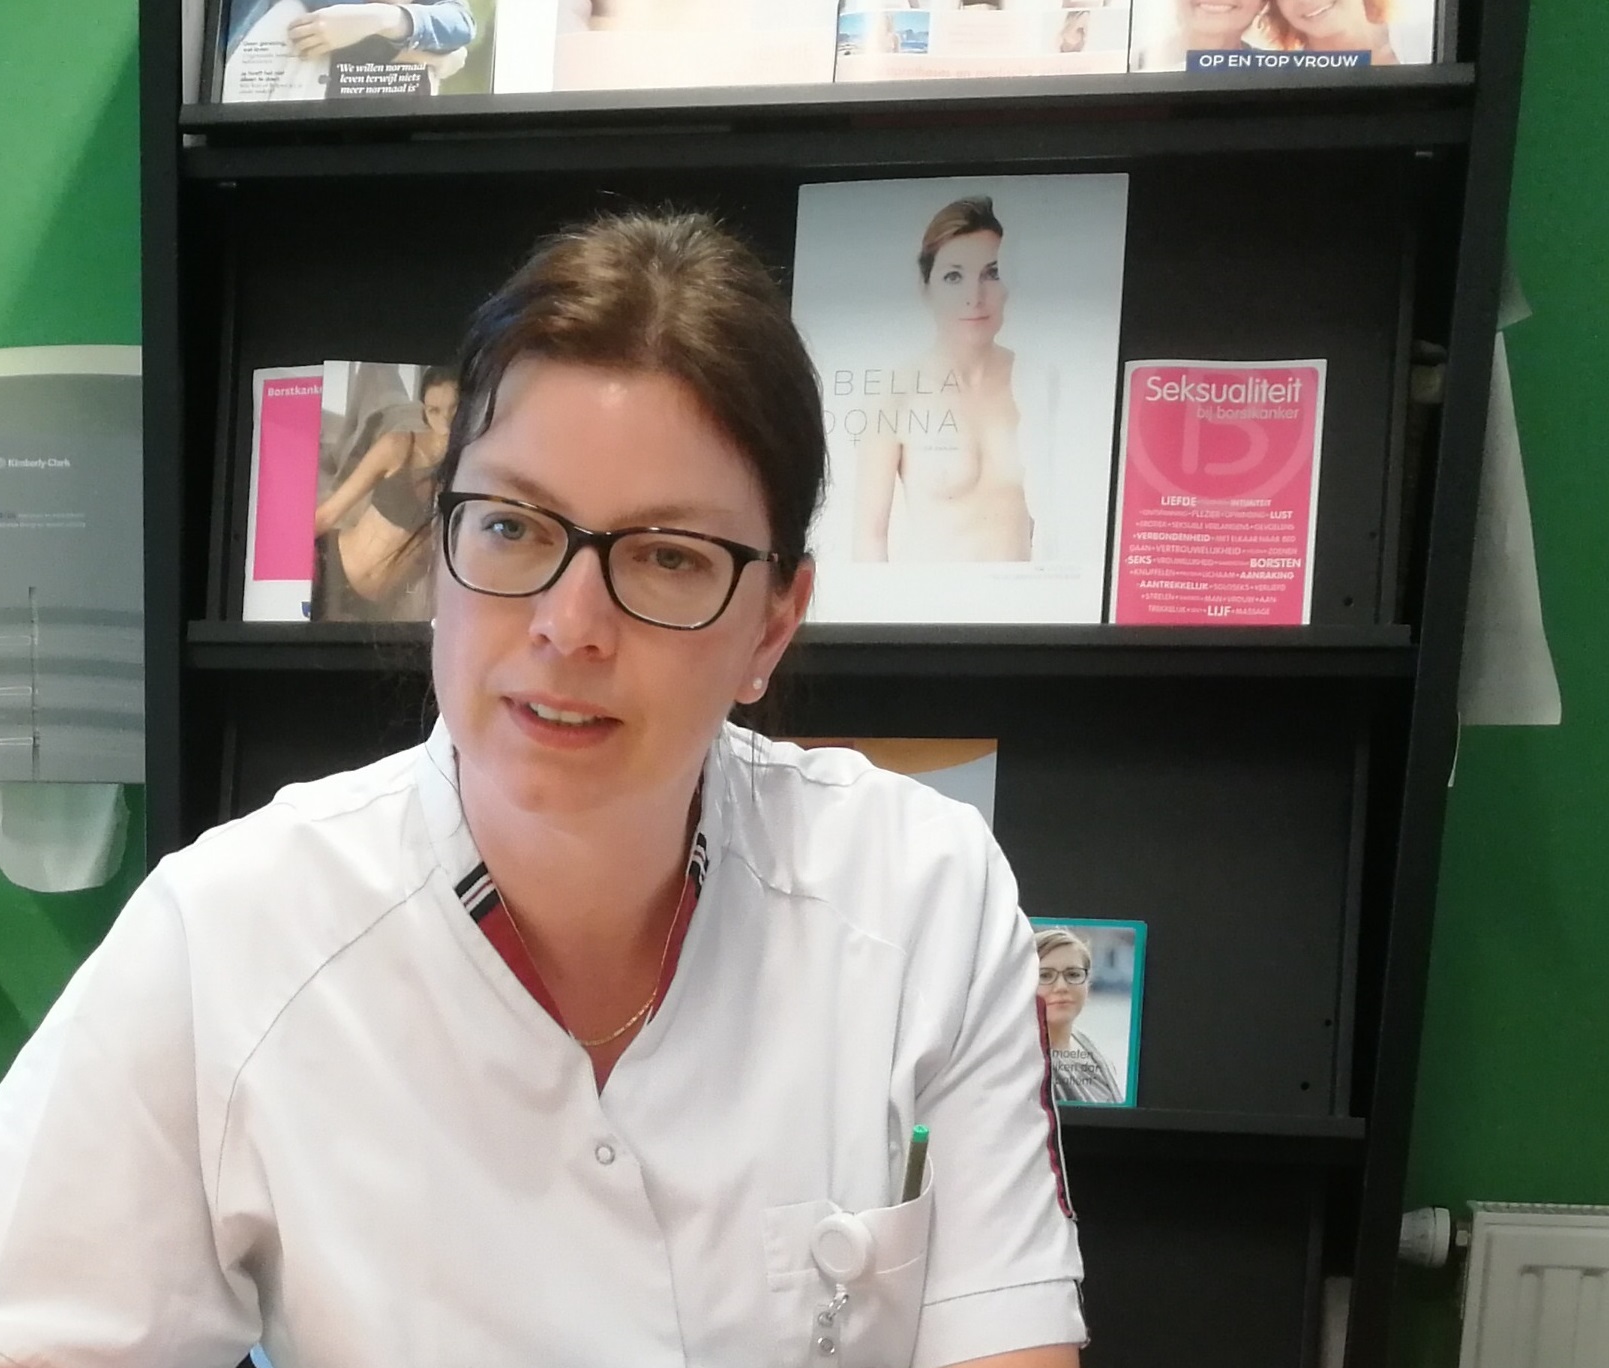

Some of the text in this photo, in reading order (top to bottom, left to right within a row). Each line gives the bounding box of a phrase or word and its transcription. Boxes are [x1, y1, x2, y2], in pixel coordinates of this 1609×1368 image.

[356, 63, 384, 72] willen
[385, 62, 427, 72] normaal
[1199, 55, 1359, 68] OP EN TOP VROUW
[340, 73, 421, 85] leven terwijl niets
[340, 86, 364, 94] meer
[365, 83, 406, 94] normaal
[834, 369, 961, 396] BELLA
[1145, 374, 1303, 404] Seksualiteit
[1196, 406, 1300, 421] bij borstkanker
[823, 409, 959, 446] DONNA
[1161, 496, 1197, 507] LIEFDE
[1270, 511, 1293, 519] LUST
[1136, 532, 1211, 542] VERBONDENHEID
[1128, 555, 1152, 565] SEKS
[1250, 558, 1301, 568] BORSTEN
[1240, 571, 1295, 579] AANRAKING
[1139, 580, 1209, 590] AANTREKKELIJK
[1208, 605, 1232, 616] LIJF
